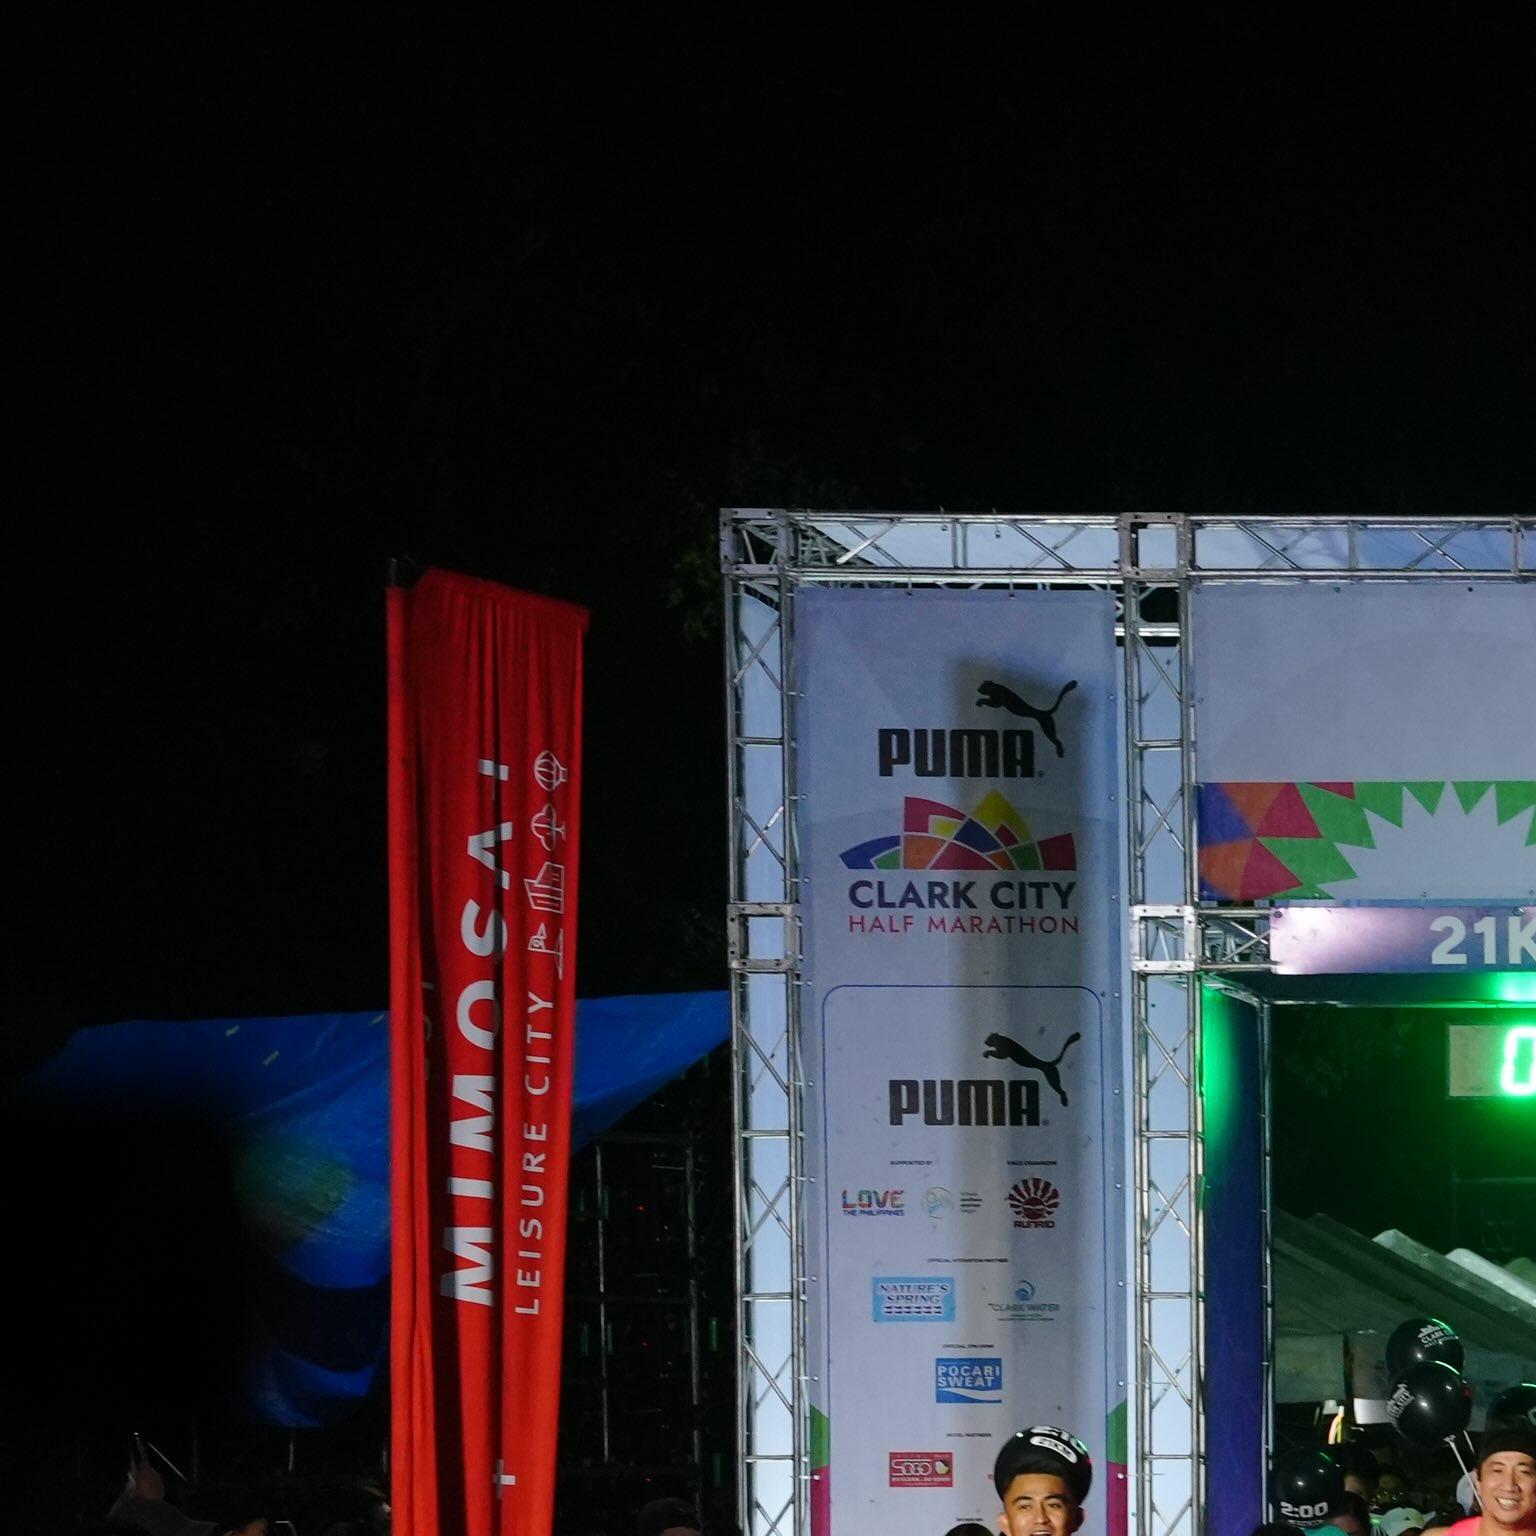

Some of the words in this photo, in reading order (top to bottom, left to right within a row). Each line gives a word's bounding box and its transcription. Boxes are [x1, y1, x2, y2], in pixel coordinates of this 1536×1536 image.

[877, 727, 1035, 779] PUMA
[847, 879, 979, 910] CLARK
[989, 880, 1077, 910] CITY
[848, 914, 915, 934] HALF
[927, 914, 1081, 935] MARATHON
[523, 991, 555, 1097] CITY
[888, 1079, 1041, 1127] PUMA
[841, 1189, 905, 1210] LOVE
[514, 1121, 548, 1316] LEISURE
[879, 1284, 950, 1293] NATURE'S
[886, 1294, 940, 1305] SPRING
[937, 1365, 1001, 1377] POCARI
[937, 1376, 994, 1388] SWEAT
[1280, 1501, 1329, 1518] 2:00
